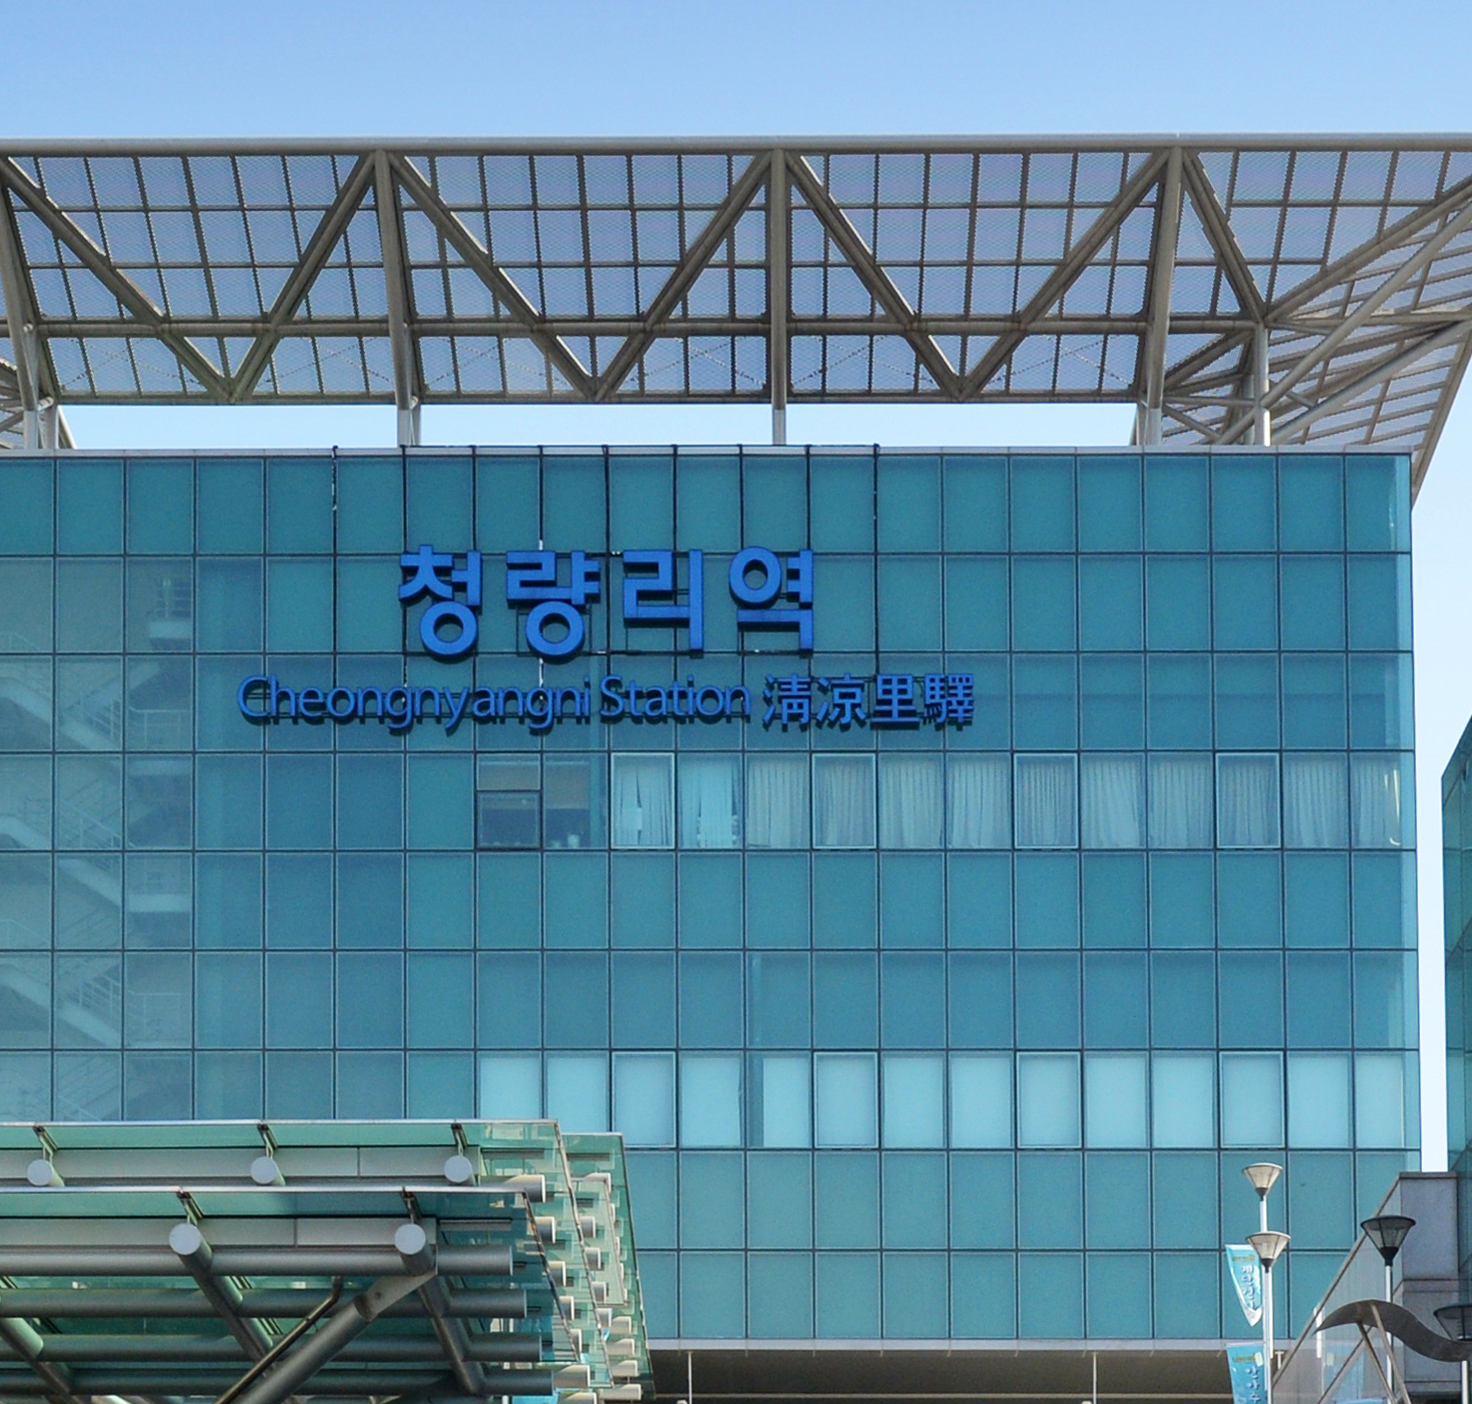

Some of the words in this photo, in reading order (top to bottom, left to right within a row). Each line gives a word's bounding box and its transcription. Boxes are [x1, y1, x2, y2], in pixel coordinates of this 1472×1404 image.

[397, 545, 815, 658] 청량리역
[236, 674, 591, 735] Cheongnyangni
[599, 674, 753, 723] Station
